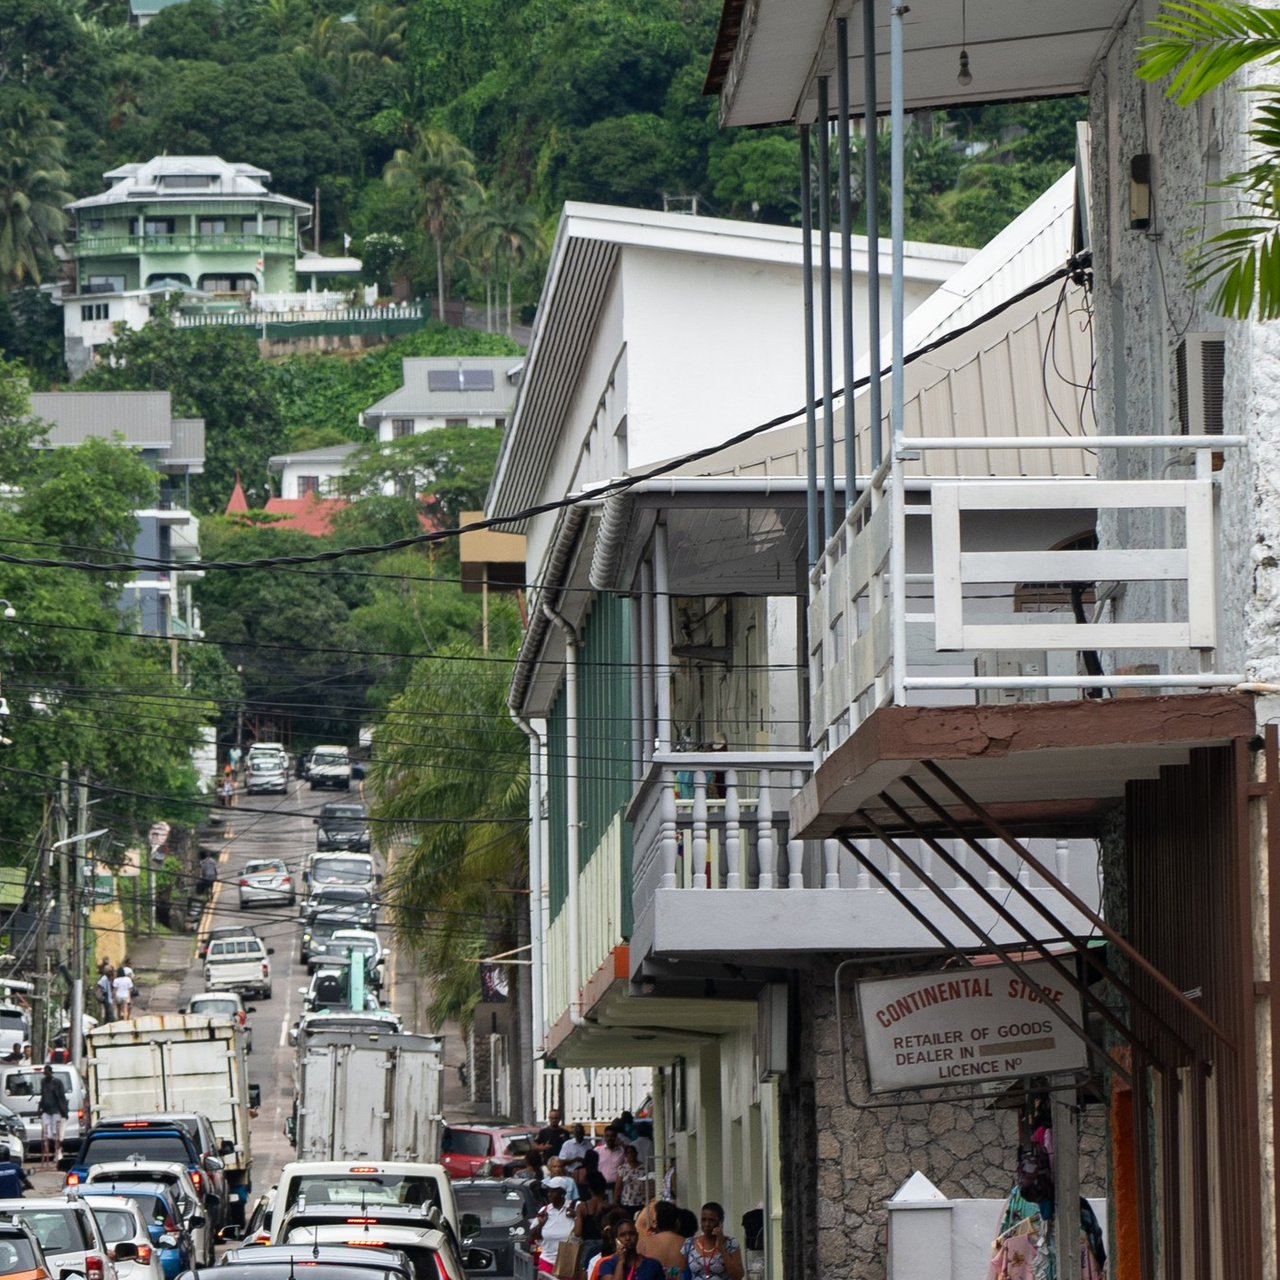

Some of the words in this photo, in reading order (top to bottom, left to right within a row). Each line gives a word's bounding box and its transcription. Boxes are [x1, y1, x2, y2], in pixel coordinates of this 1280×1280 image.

[876, 978, 993, 1028] CONTINENTAL
[893, 1030, 963, 1050] RETAILER
[970, 1027, 990, 1041] OF
[997, 1020, 1053, 1038] GOODS
[895, 1047, 954, 1066] DEALER
[960, 1046, 975, 1059] IN
[938, 1060, 999, 1079] LICENCE
